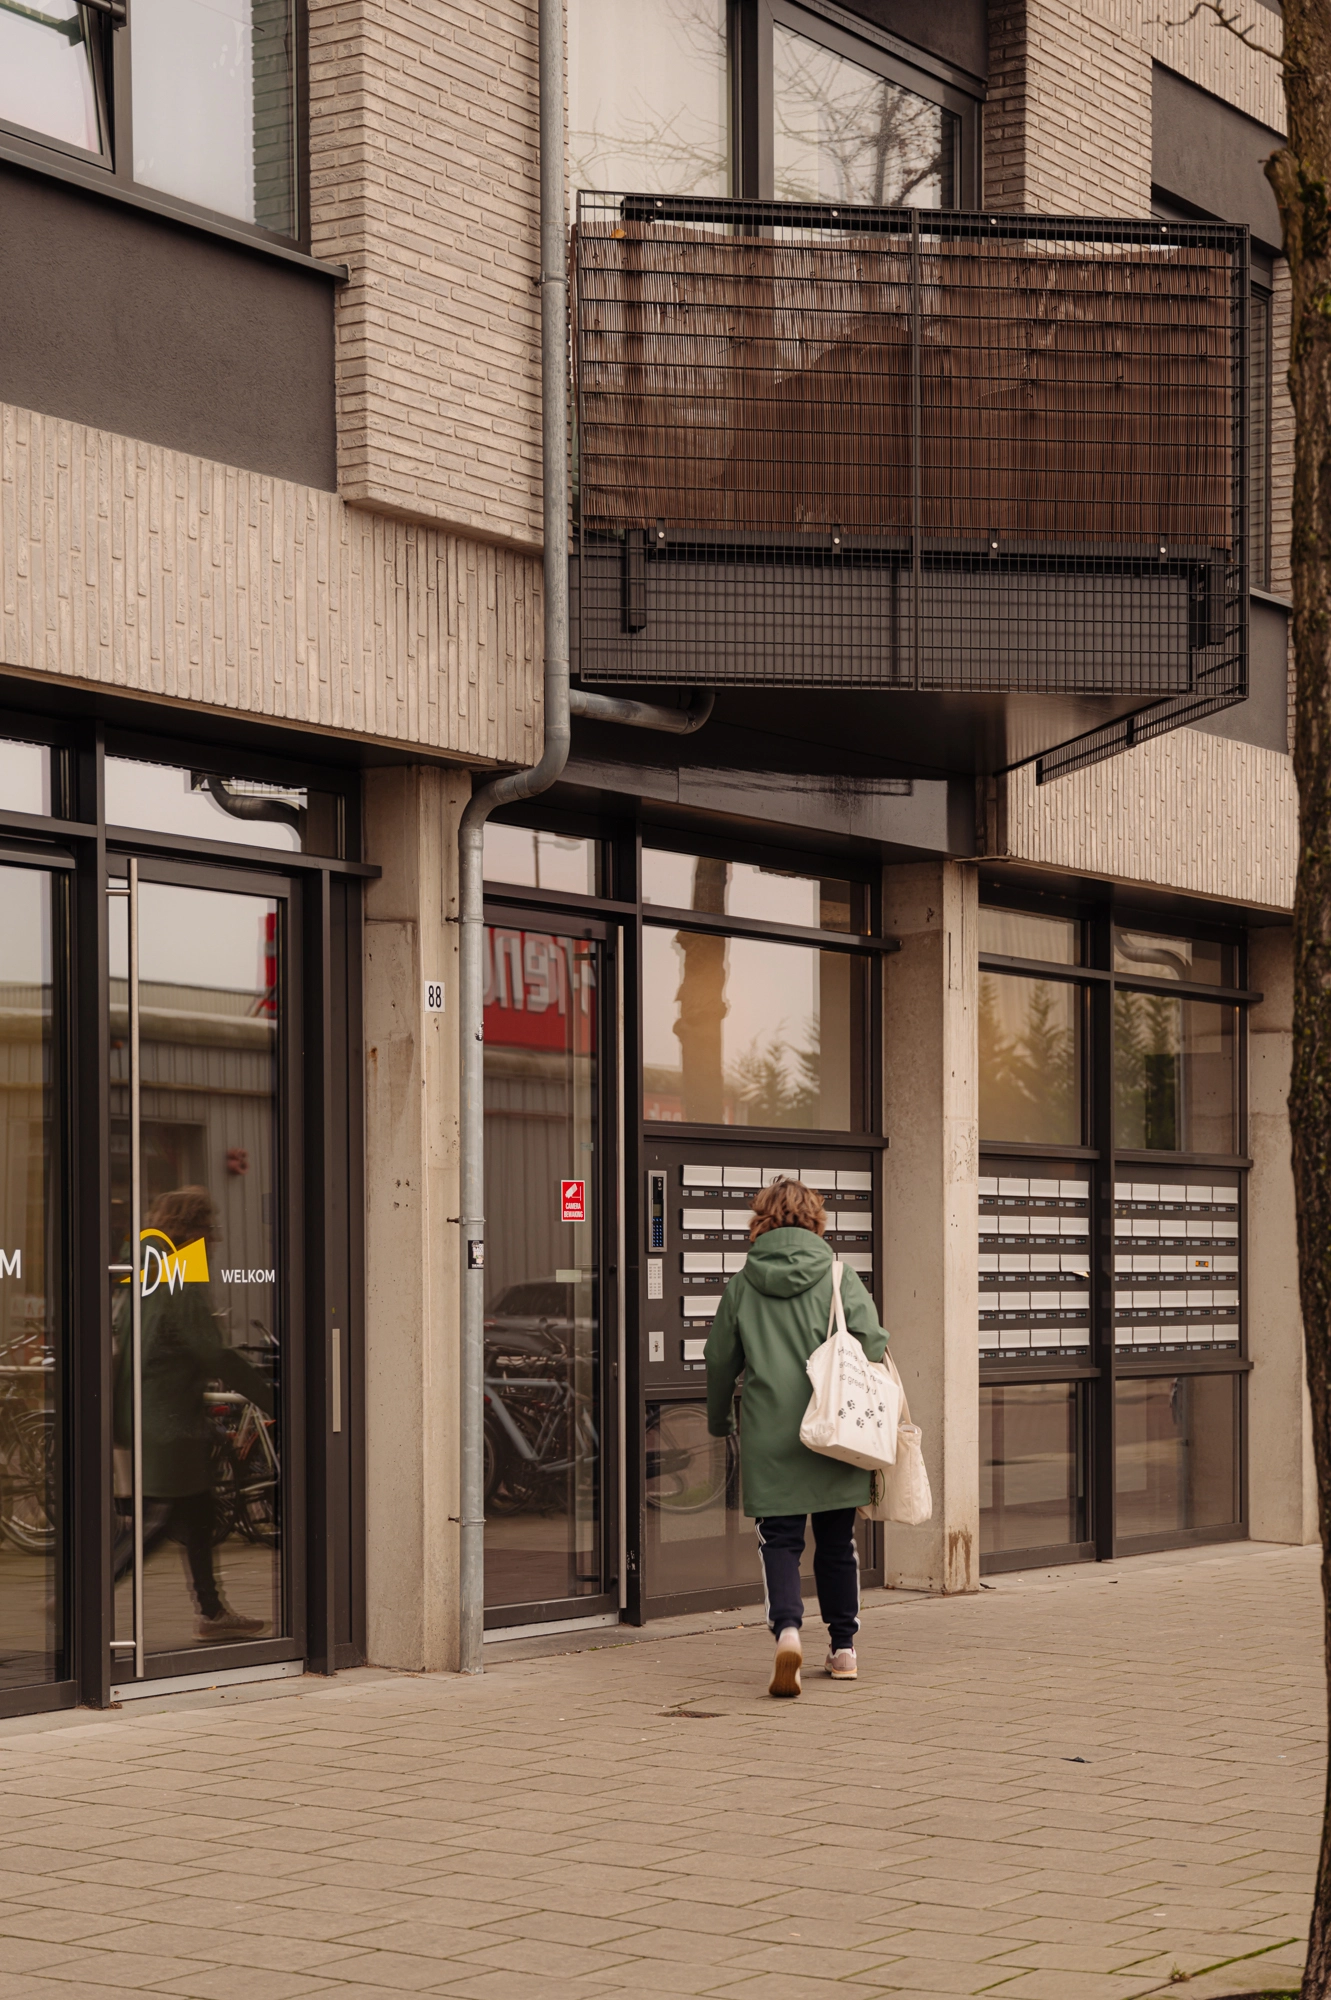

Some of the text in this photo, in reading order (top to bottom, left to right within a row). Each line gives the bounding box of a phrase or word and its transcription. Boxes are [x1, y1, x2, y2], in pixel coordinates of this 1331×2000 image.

[428, 985, 442, 1008] 88
[565, 1202, 582, 1210] CAMERA
[563, 1210, 584, 1218] BEWAKING
[221, 1269, 275, 1283] WELKOM
[839, 1361, 866, 1377] someon
[866, 1385, 877, 1395] yu
